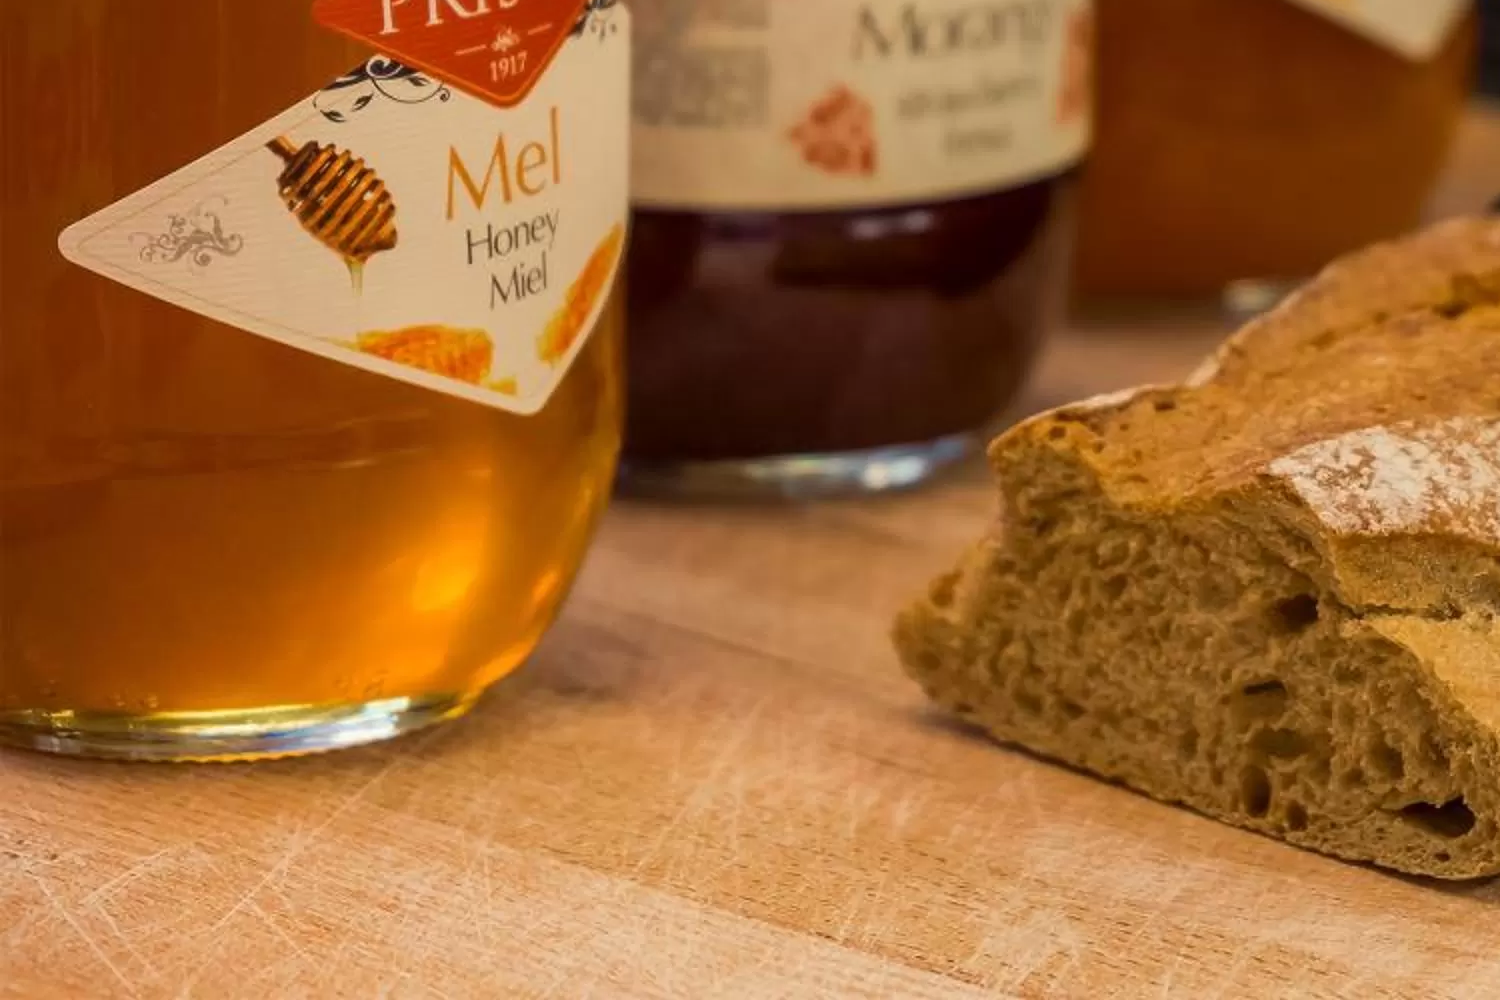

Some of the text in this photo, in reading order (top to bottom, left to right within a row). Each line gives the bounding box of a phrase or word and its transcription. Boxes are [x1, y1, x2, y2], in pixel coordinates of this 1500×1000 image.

[490, 51, 528, 82] 1917
[446, 106, 560, 220] Mel
[466, 209, 560, 265] Honey
[490, 251, 548, 311] Miel
